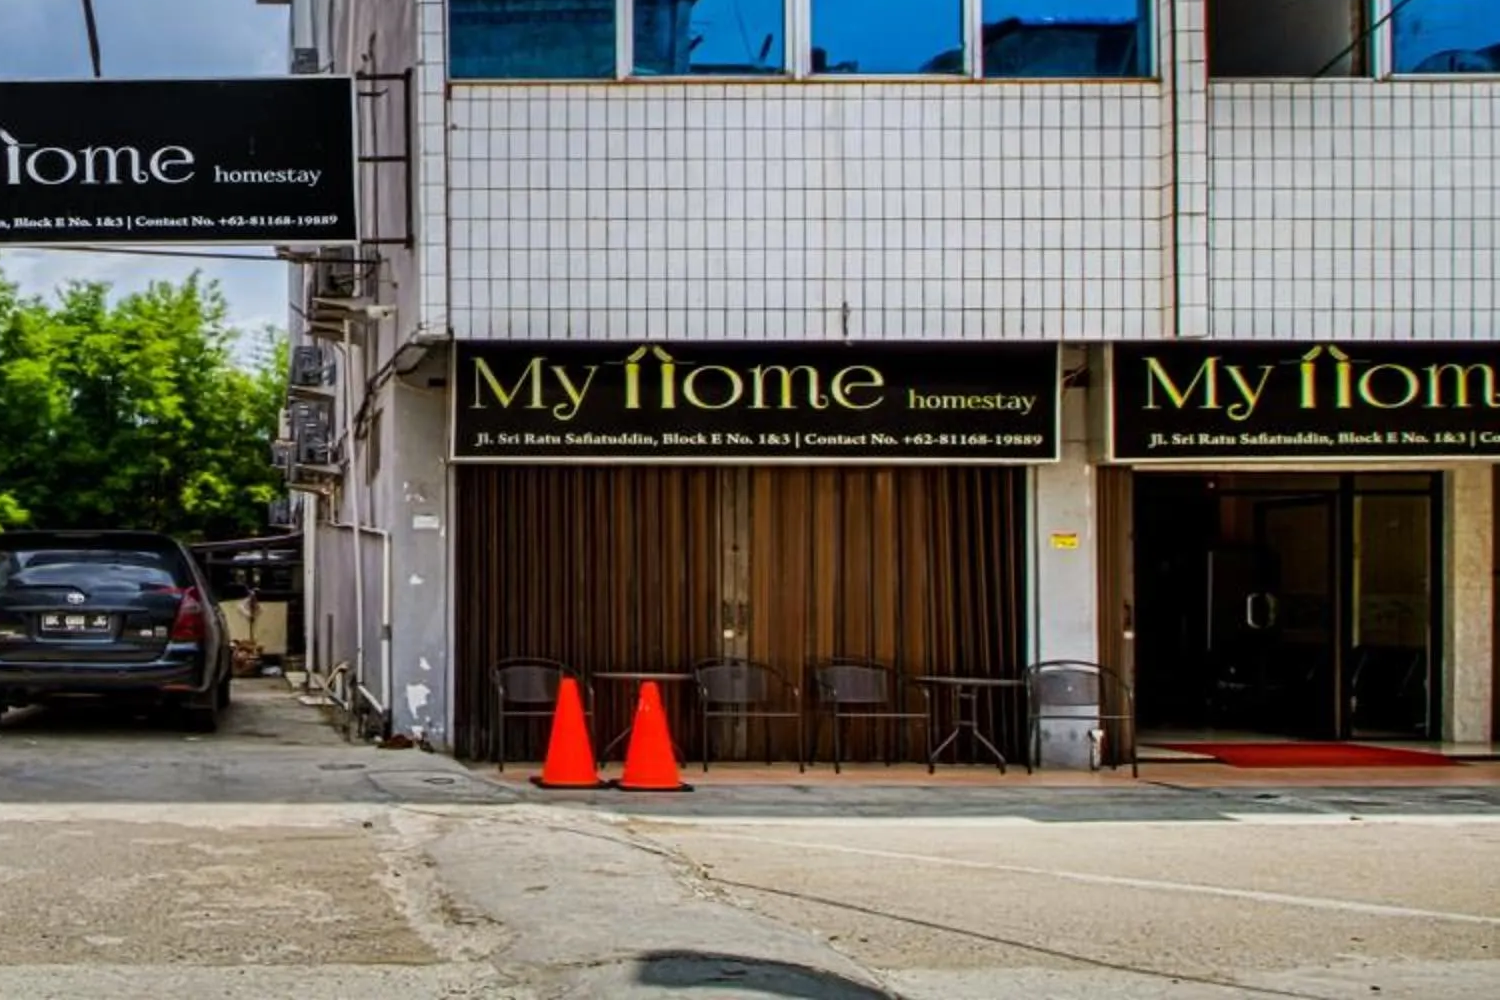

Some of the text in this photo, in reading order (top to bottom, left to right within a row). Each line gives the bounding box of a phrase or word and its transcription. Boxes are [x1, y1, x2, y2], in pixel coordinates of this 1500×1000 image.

[214, 165, 322, 187] homestay
[13, 217, 53, 228] Block
[55, 217, 65, 227] E
[67, 217, 93, 227] No.
[96, 216, 124, 227] 1&3
[134, 216, 188, 227] Contact
[191, 216, 215, 227] No.
[470, 357, 598, 420] My
[908, 388, 1037, 415] homestay
[1142, 356, 1275, 421] My
[475, 432, 494, 447] Jl.
[498, 433, 520, 445] Sri
[524, 433, 562, 445] Ratu
[565, 432, 659, 446] Safiatuddin,
[662, 433, 708, 445] Block
[711, 433, 723, 445] E
[726, 433, 754, 445] No.
[759, 433, 791, 445] 1&3
[804, 433, 867, 445] Contact
[871, 433, 899, 445] No.
[903, 433, 1043, 446] +62-81168-19889
[1149, 433, 1168, 448] Jl.
[1171, 433, 1195, 445] Sri
[1198, 433, 1237, 445] Ratu
[1239, 432, 1335, 446] Safiatuddin,
[1338, 431, 1383, 444] Block
[1386, 431, 1398, 443] E
[1401, 432, 1429, 443] No.
[1434, 432, 1466, 443] 1&3
